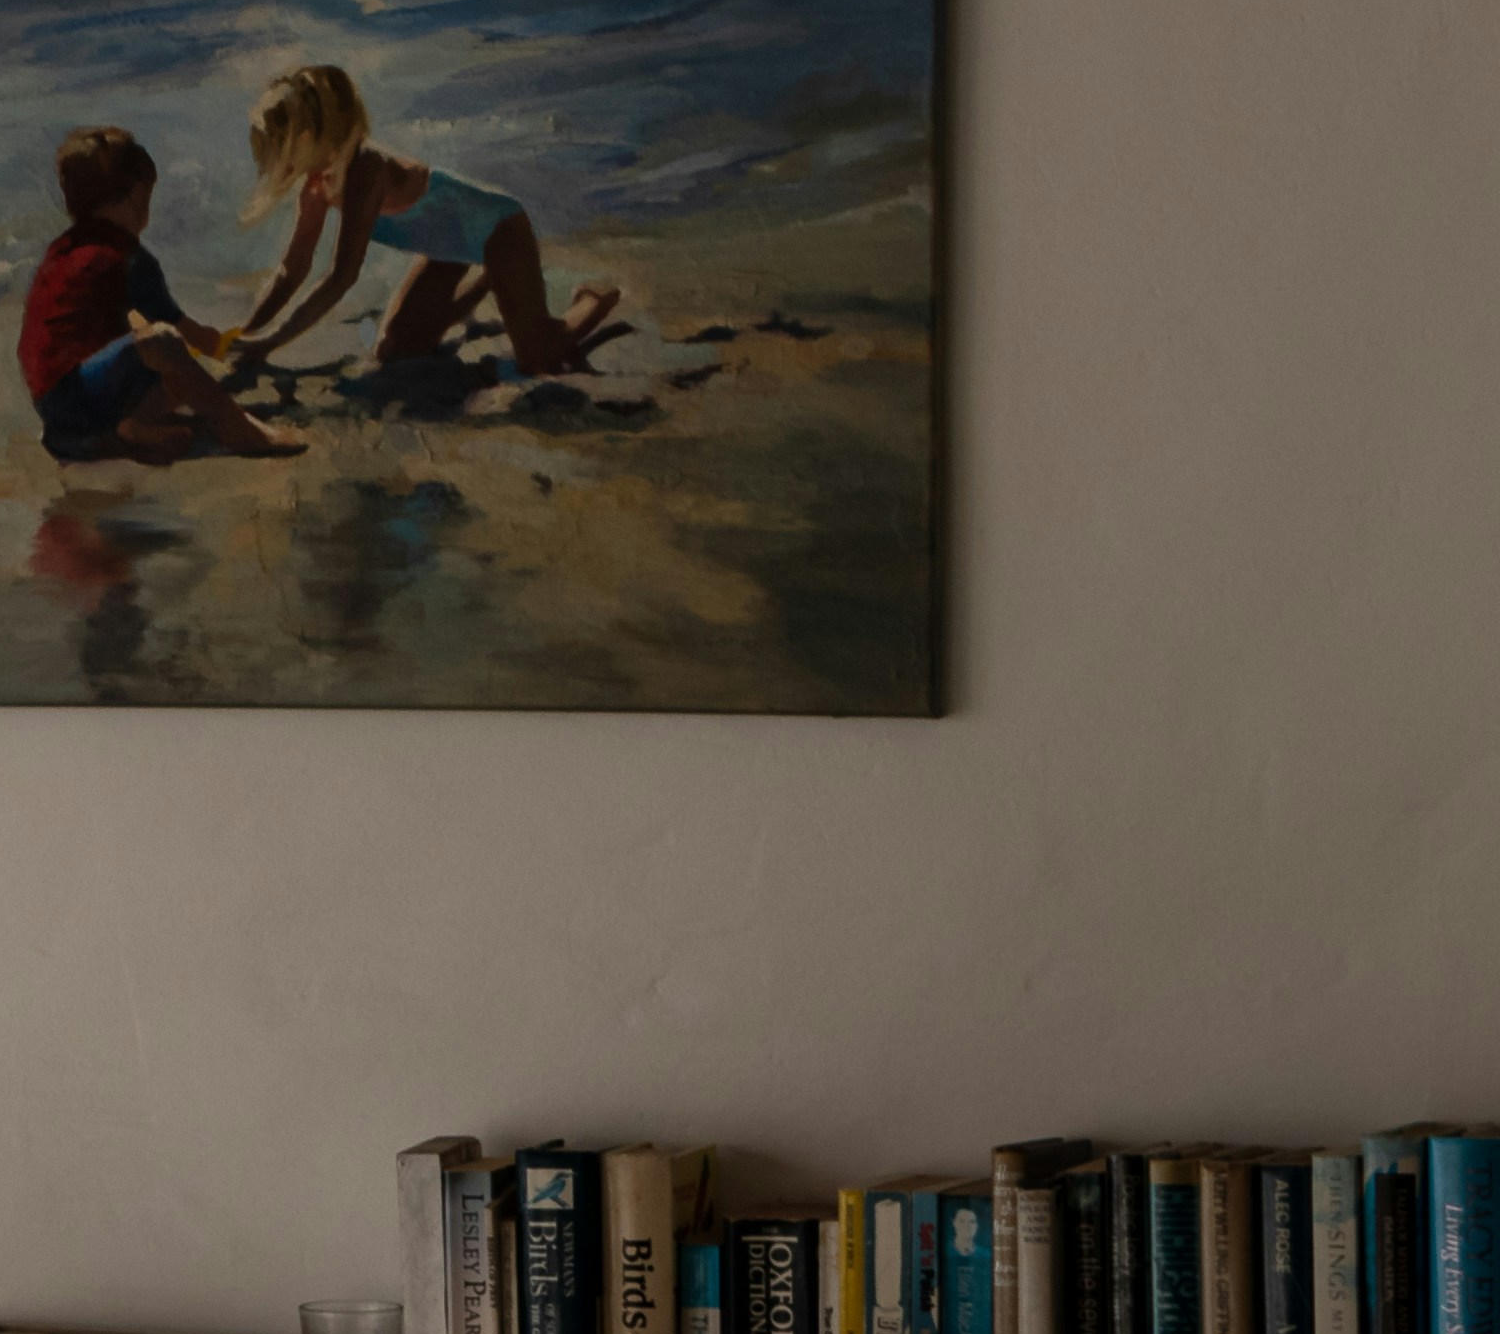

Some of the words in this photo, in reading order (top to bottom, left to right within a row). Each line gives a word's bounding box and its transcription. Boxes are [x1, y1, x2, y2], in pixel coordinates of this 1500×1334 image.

[1274, 1179, 1291, 1224] ALEC
[1465, 1162, 1492, 1265] TRACY
[461, 1194, 486, 1274] LESLEY
[527, 1218, 559, 1298] Birds
[1077, 1223, 1095, 1249] on
[1274, 1227, 1292, 1274] ROSE
[1440, 1202, 1464, 1263] Living
[621, 1237, 655, 1329] Birds
[1077, 1253, 1101, 1289] the
[1327, 1229, 1352, 1302] SINGS
[1440, 1267, 1464, 1319] Every
[1330, 1308, 1344, 1332] MY
